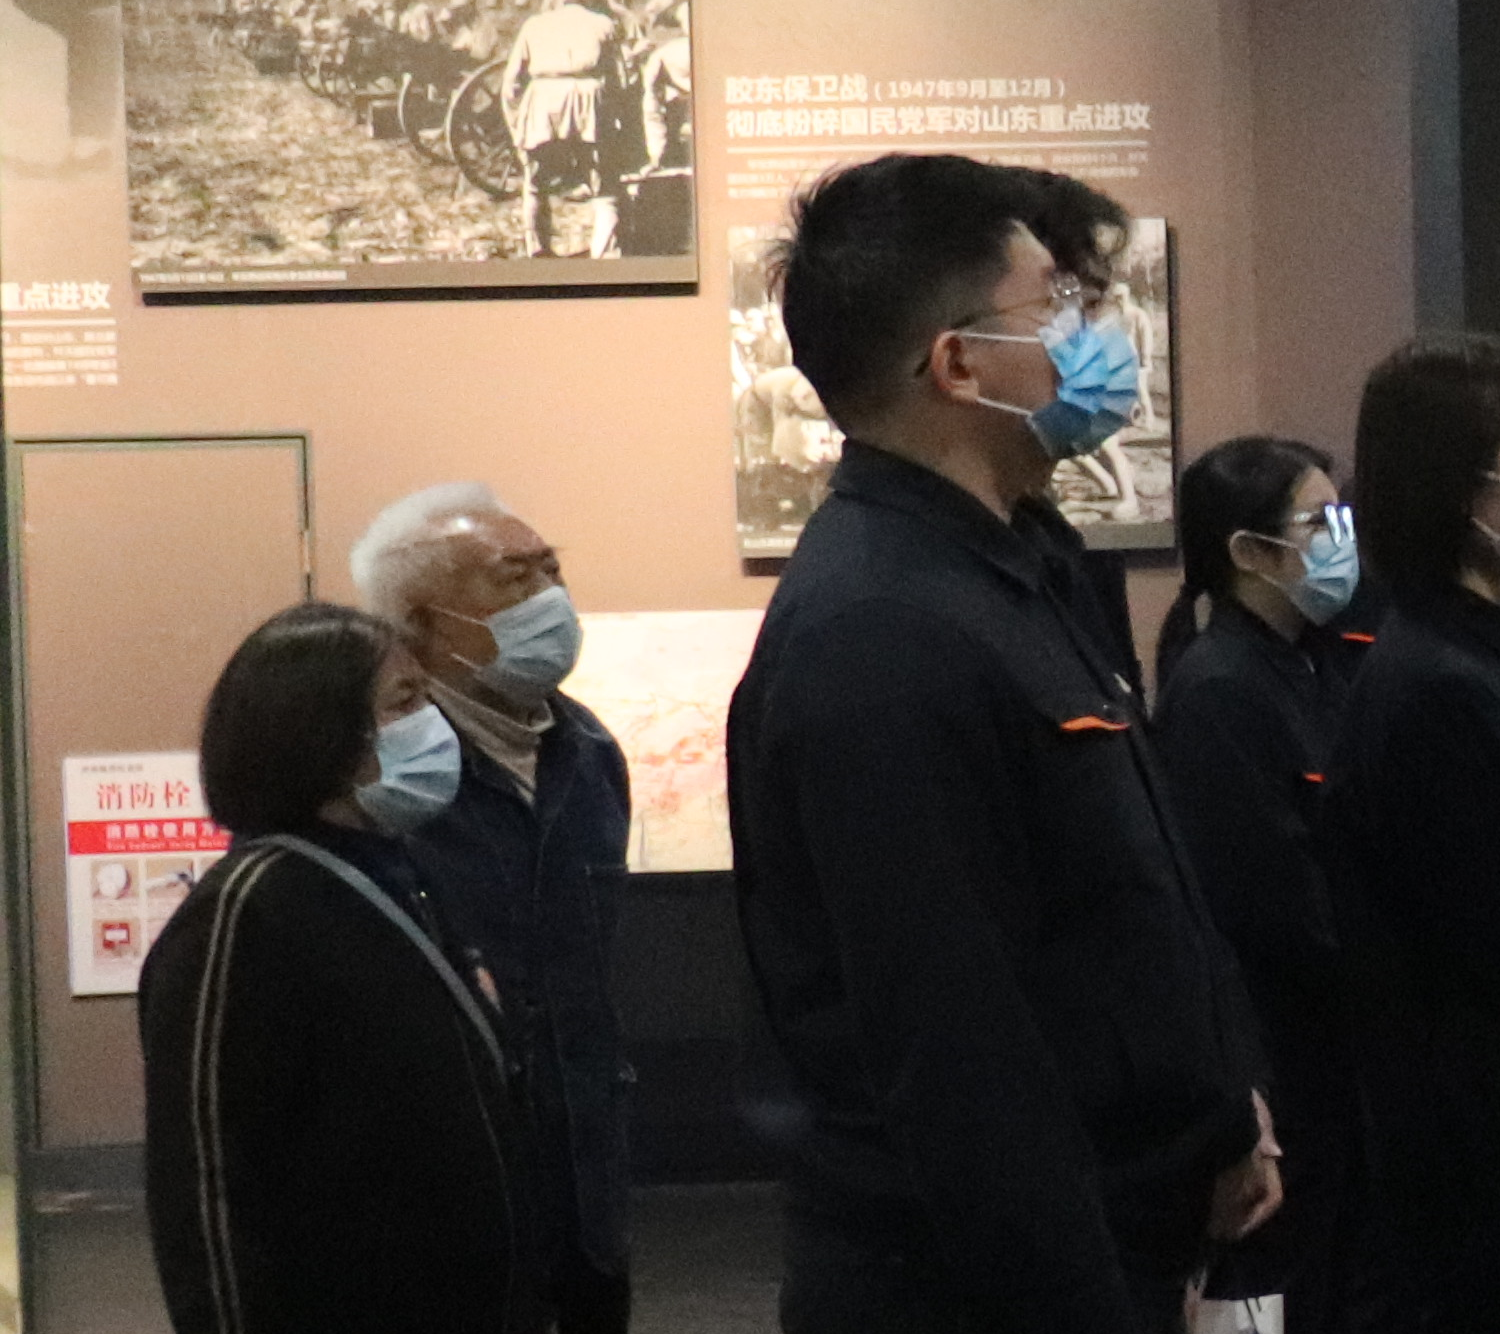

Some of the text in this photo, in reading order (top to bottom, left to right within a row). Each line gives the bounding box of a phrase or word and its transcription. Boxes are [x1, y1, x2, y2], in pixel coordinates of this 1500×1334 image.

[726, 102, 1151, 138] 彻底粉碎国民党军对山东重点进攻
[97, 779, 191, 810] 消防栓
